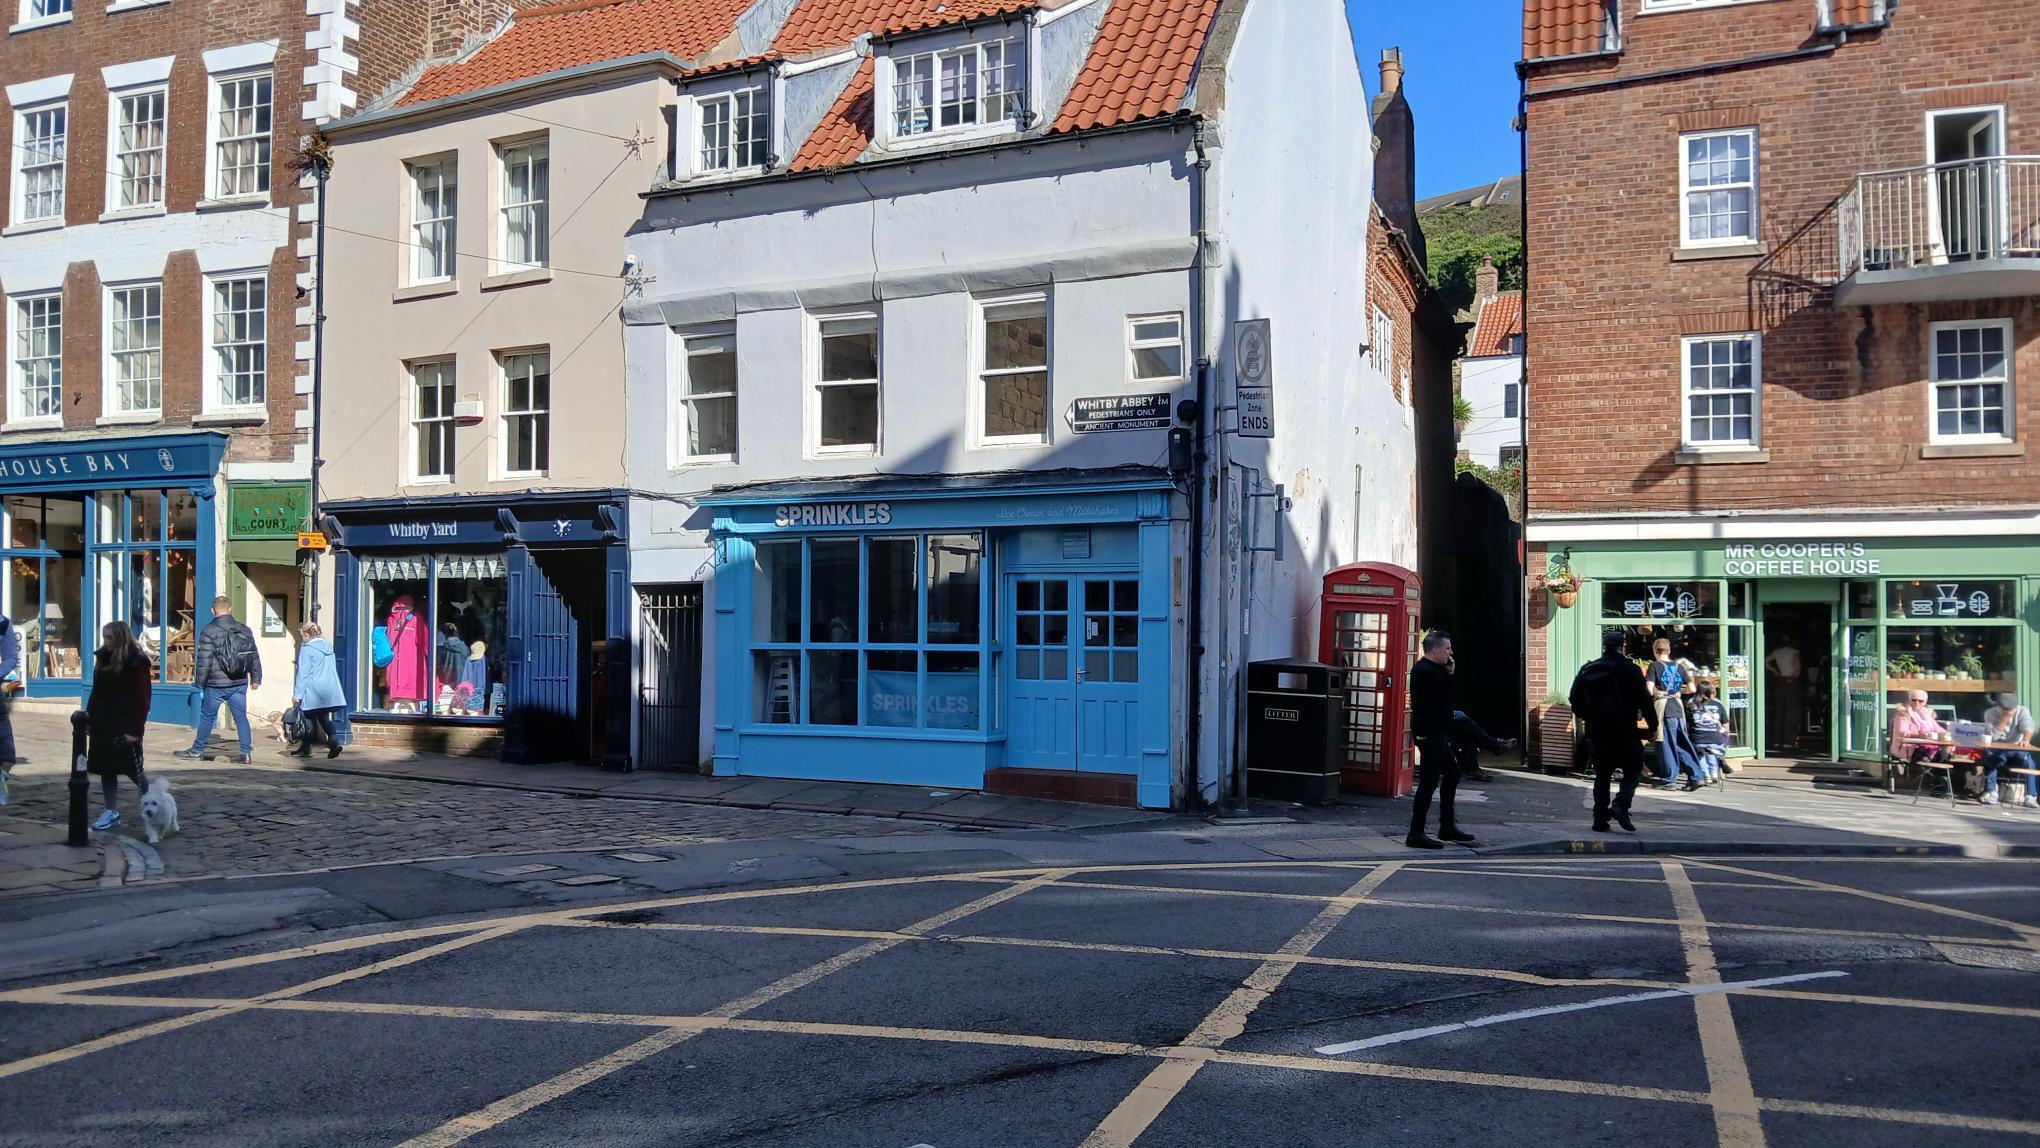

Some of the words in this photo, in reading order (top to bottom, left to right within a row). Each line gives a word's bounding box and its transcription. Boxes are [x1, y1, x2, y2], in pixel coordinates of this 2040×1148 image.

[1077, 398, 1119, 410] WHITBY
[1120, 396, 1154, 407] ABBEY
[1238, 391, 1270, 401] Pedestrian
[1136, 408, 1156, 417] ONLY
[1247, 403, 1262, 412] Zone
[1084, 422, 1115, 431] ANCIENT
[1117, 420, 1159, 429] MONUMENT
[1241, 416, 1269, 430] ENDS
[86, 453, 131, 472] BAY
[775, 503, 891, 527] SPRINKLES
[1016, 506, 1045, 518] Cream
[1047, 507, 1064, 517] and
[1066, 504, 1119, 516] Milkshakes
[250, 518, 288, 529] COURT
[389, 521, 430, 540] Whitby
[431, 520, 458, 536] Yard
[1725, 543, 1756, 558] MR
[1760, 542, 1865, 558] COOPER'S
[1725, 560, 1804, 575] COFFEE
[1810, 559, 1881, 574] HOUSE
[1847, 655, 1879, 668] BREWS
[1268, 710, 1296, 719] LITTER
